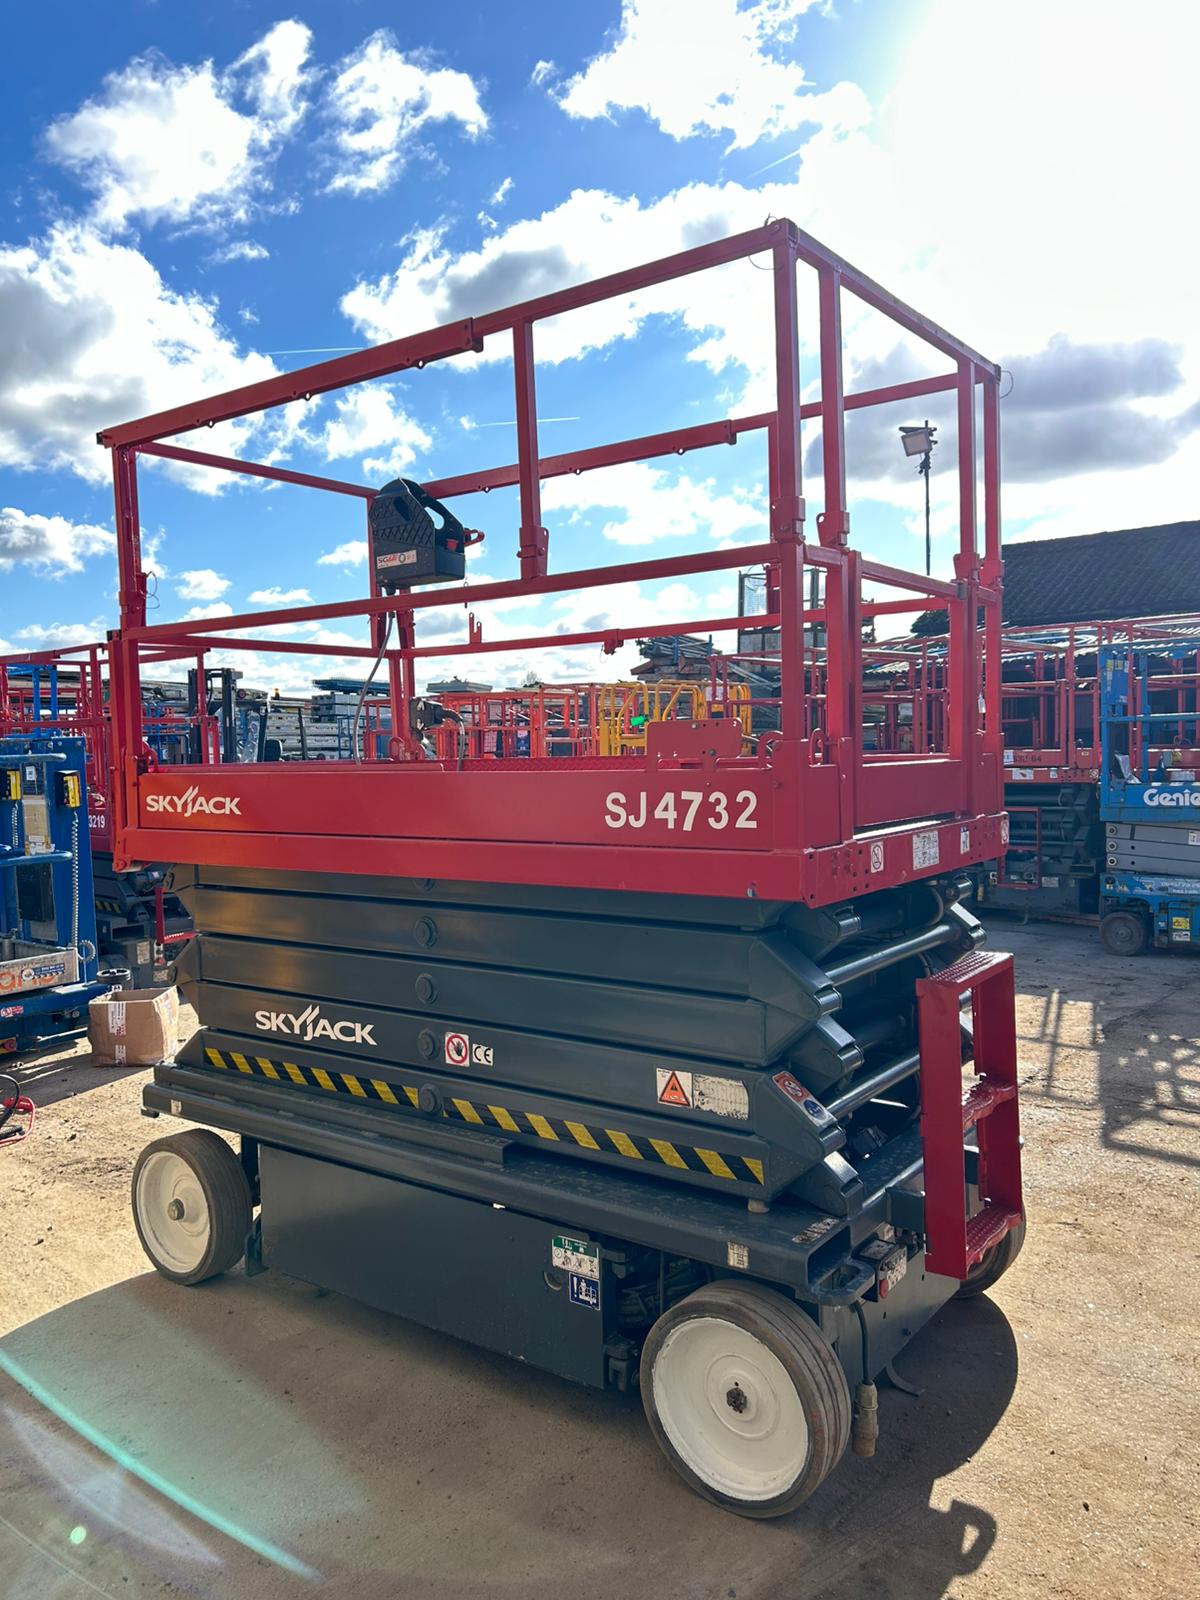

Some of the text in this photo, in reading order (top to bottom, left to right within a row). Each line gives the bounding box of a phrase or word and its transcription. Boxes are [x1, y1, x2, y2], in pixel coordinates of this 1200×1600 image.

[146, 785, 242, 817] SKYJACK
[604, 790, 758, 832] SJ4732
[255, 1004, 378, 1046] SKYJACK
